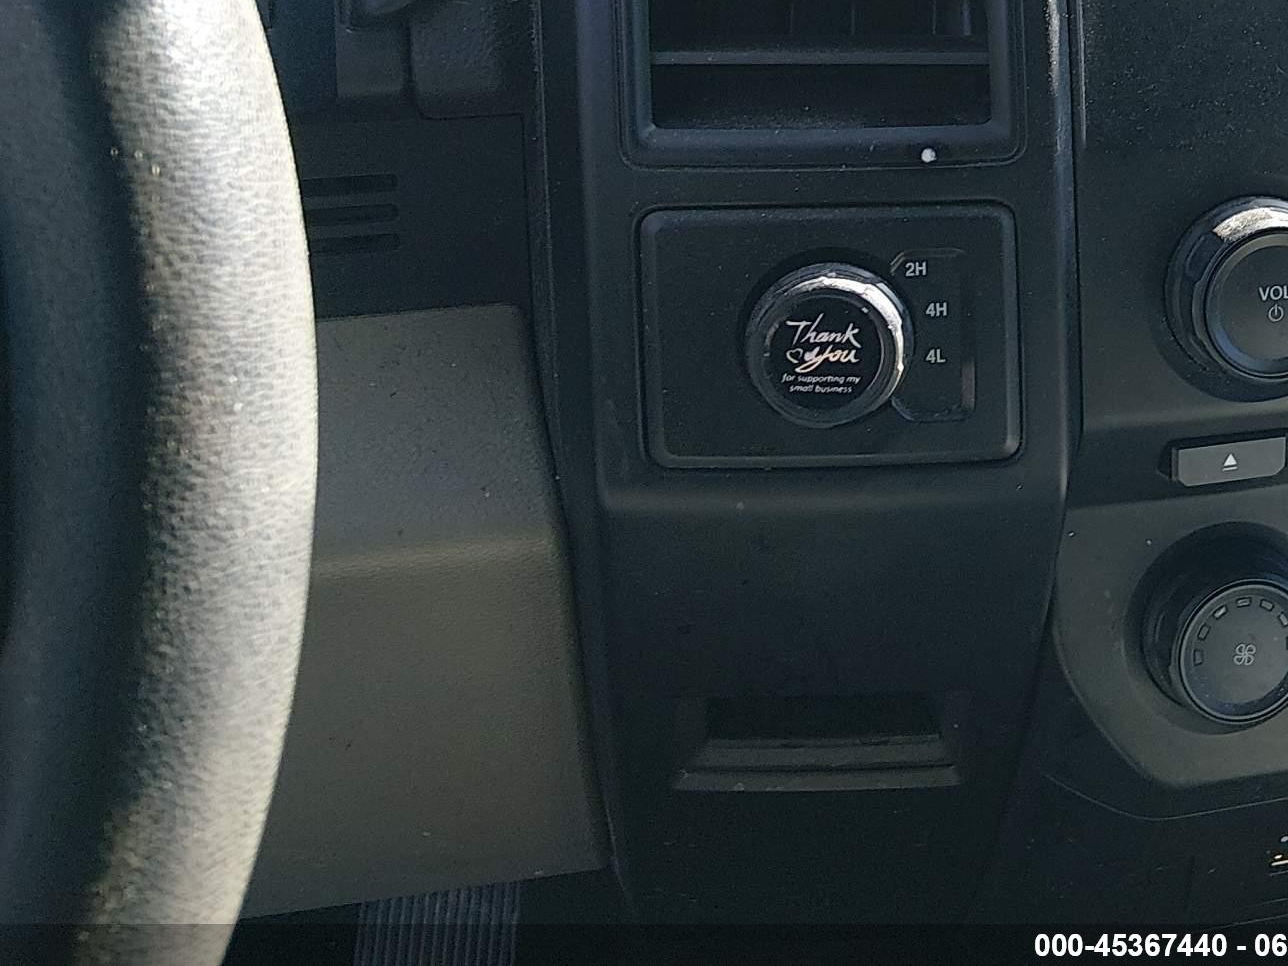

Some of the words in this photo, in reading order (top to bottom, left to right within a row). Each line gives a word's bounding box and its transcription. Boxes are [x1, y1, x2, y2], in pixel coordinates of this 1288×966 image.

[905, 262, 927, 277] 2H
[925, 302, 948, 317] 4H
[785, 313, 862, 348] Thank
[925, 349, 946, 364] 4L
[781, 373, 796, 383] for
[797, 375, 845, 385] supporting
[846, 376, 861, 384] my
[789, 385, 814, 393] small
[814, 385, 853, 394] business
